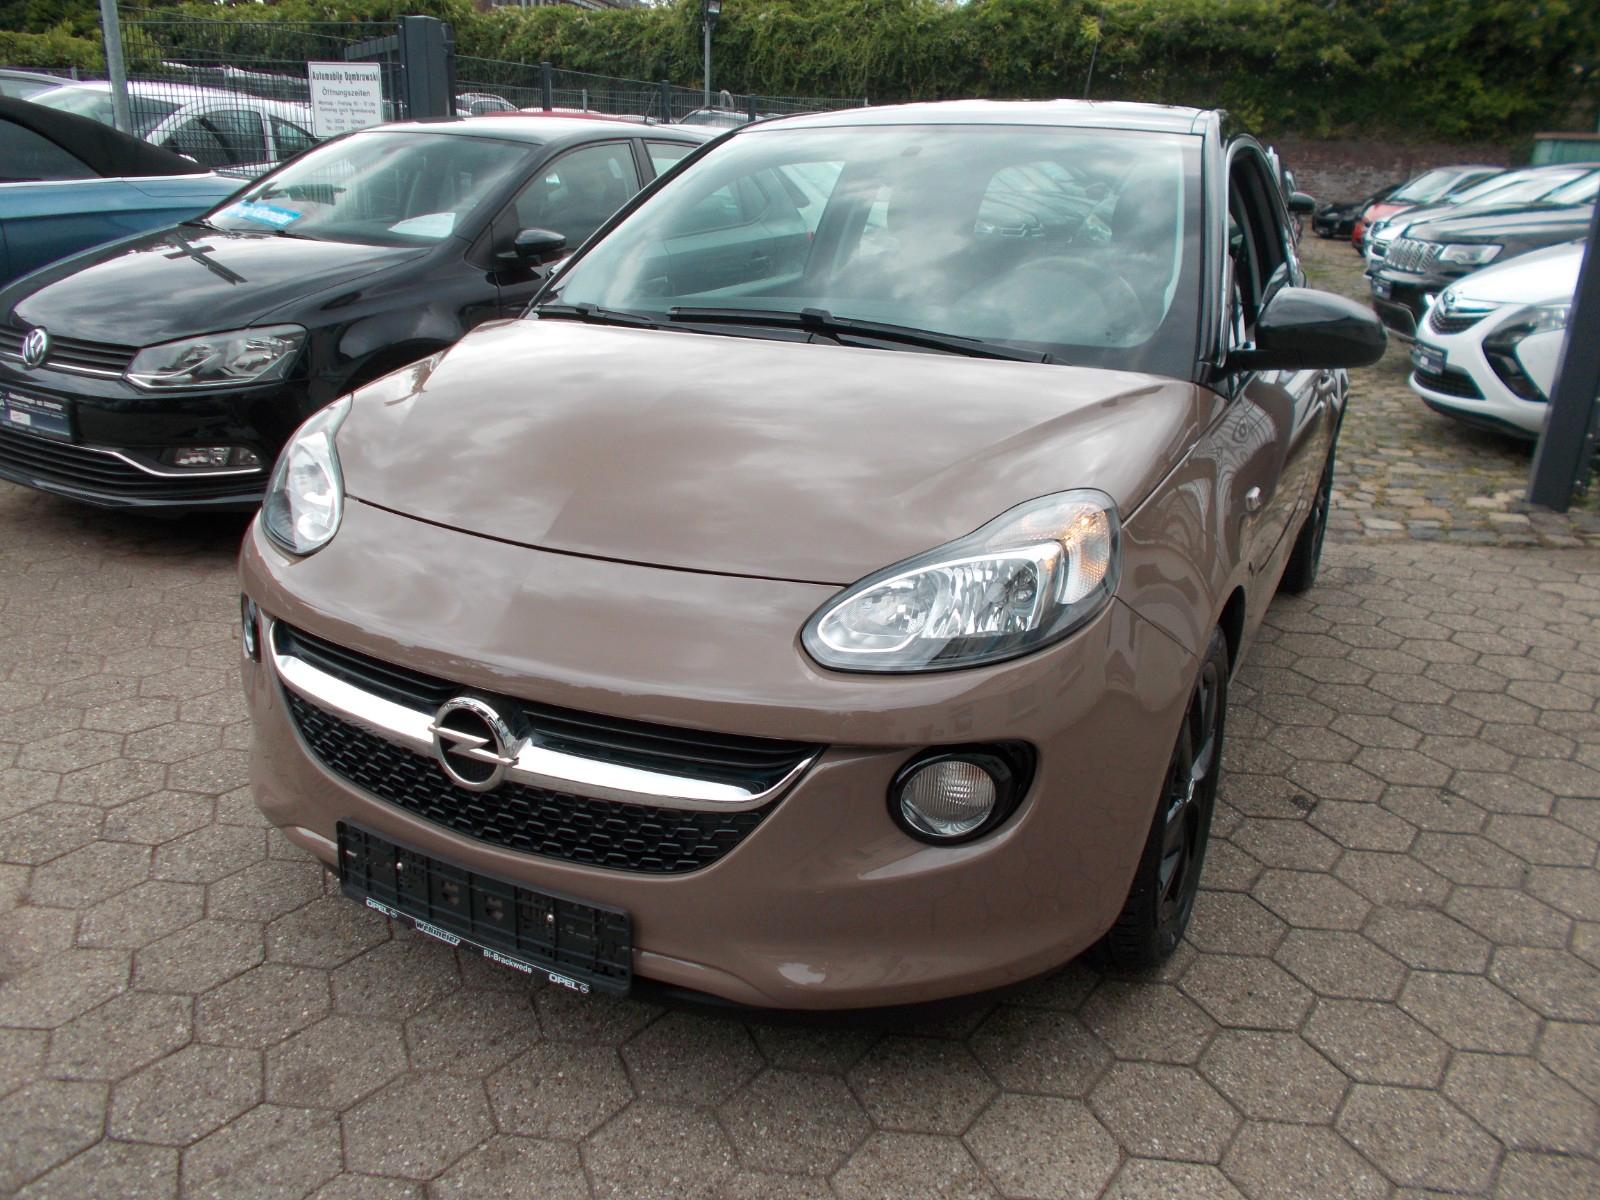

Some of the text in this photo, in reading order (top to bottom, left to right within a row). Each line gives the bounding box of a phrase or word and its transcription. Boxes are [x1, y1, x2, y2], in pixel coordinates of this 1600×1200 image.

[321, 86, 371, 97] Öffnungszeiten
[366, 899, 390, 916] OPEL
[548, 973, 579, 991] OPEL
